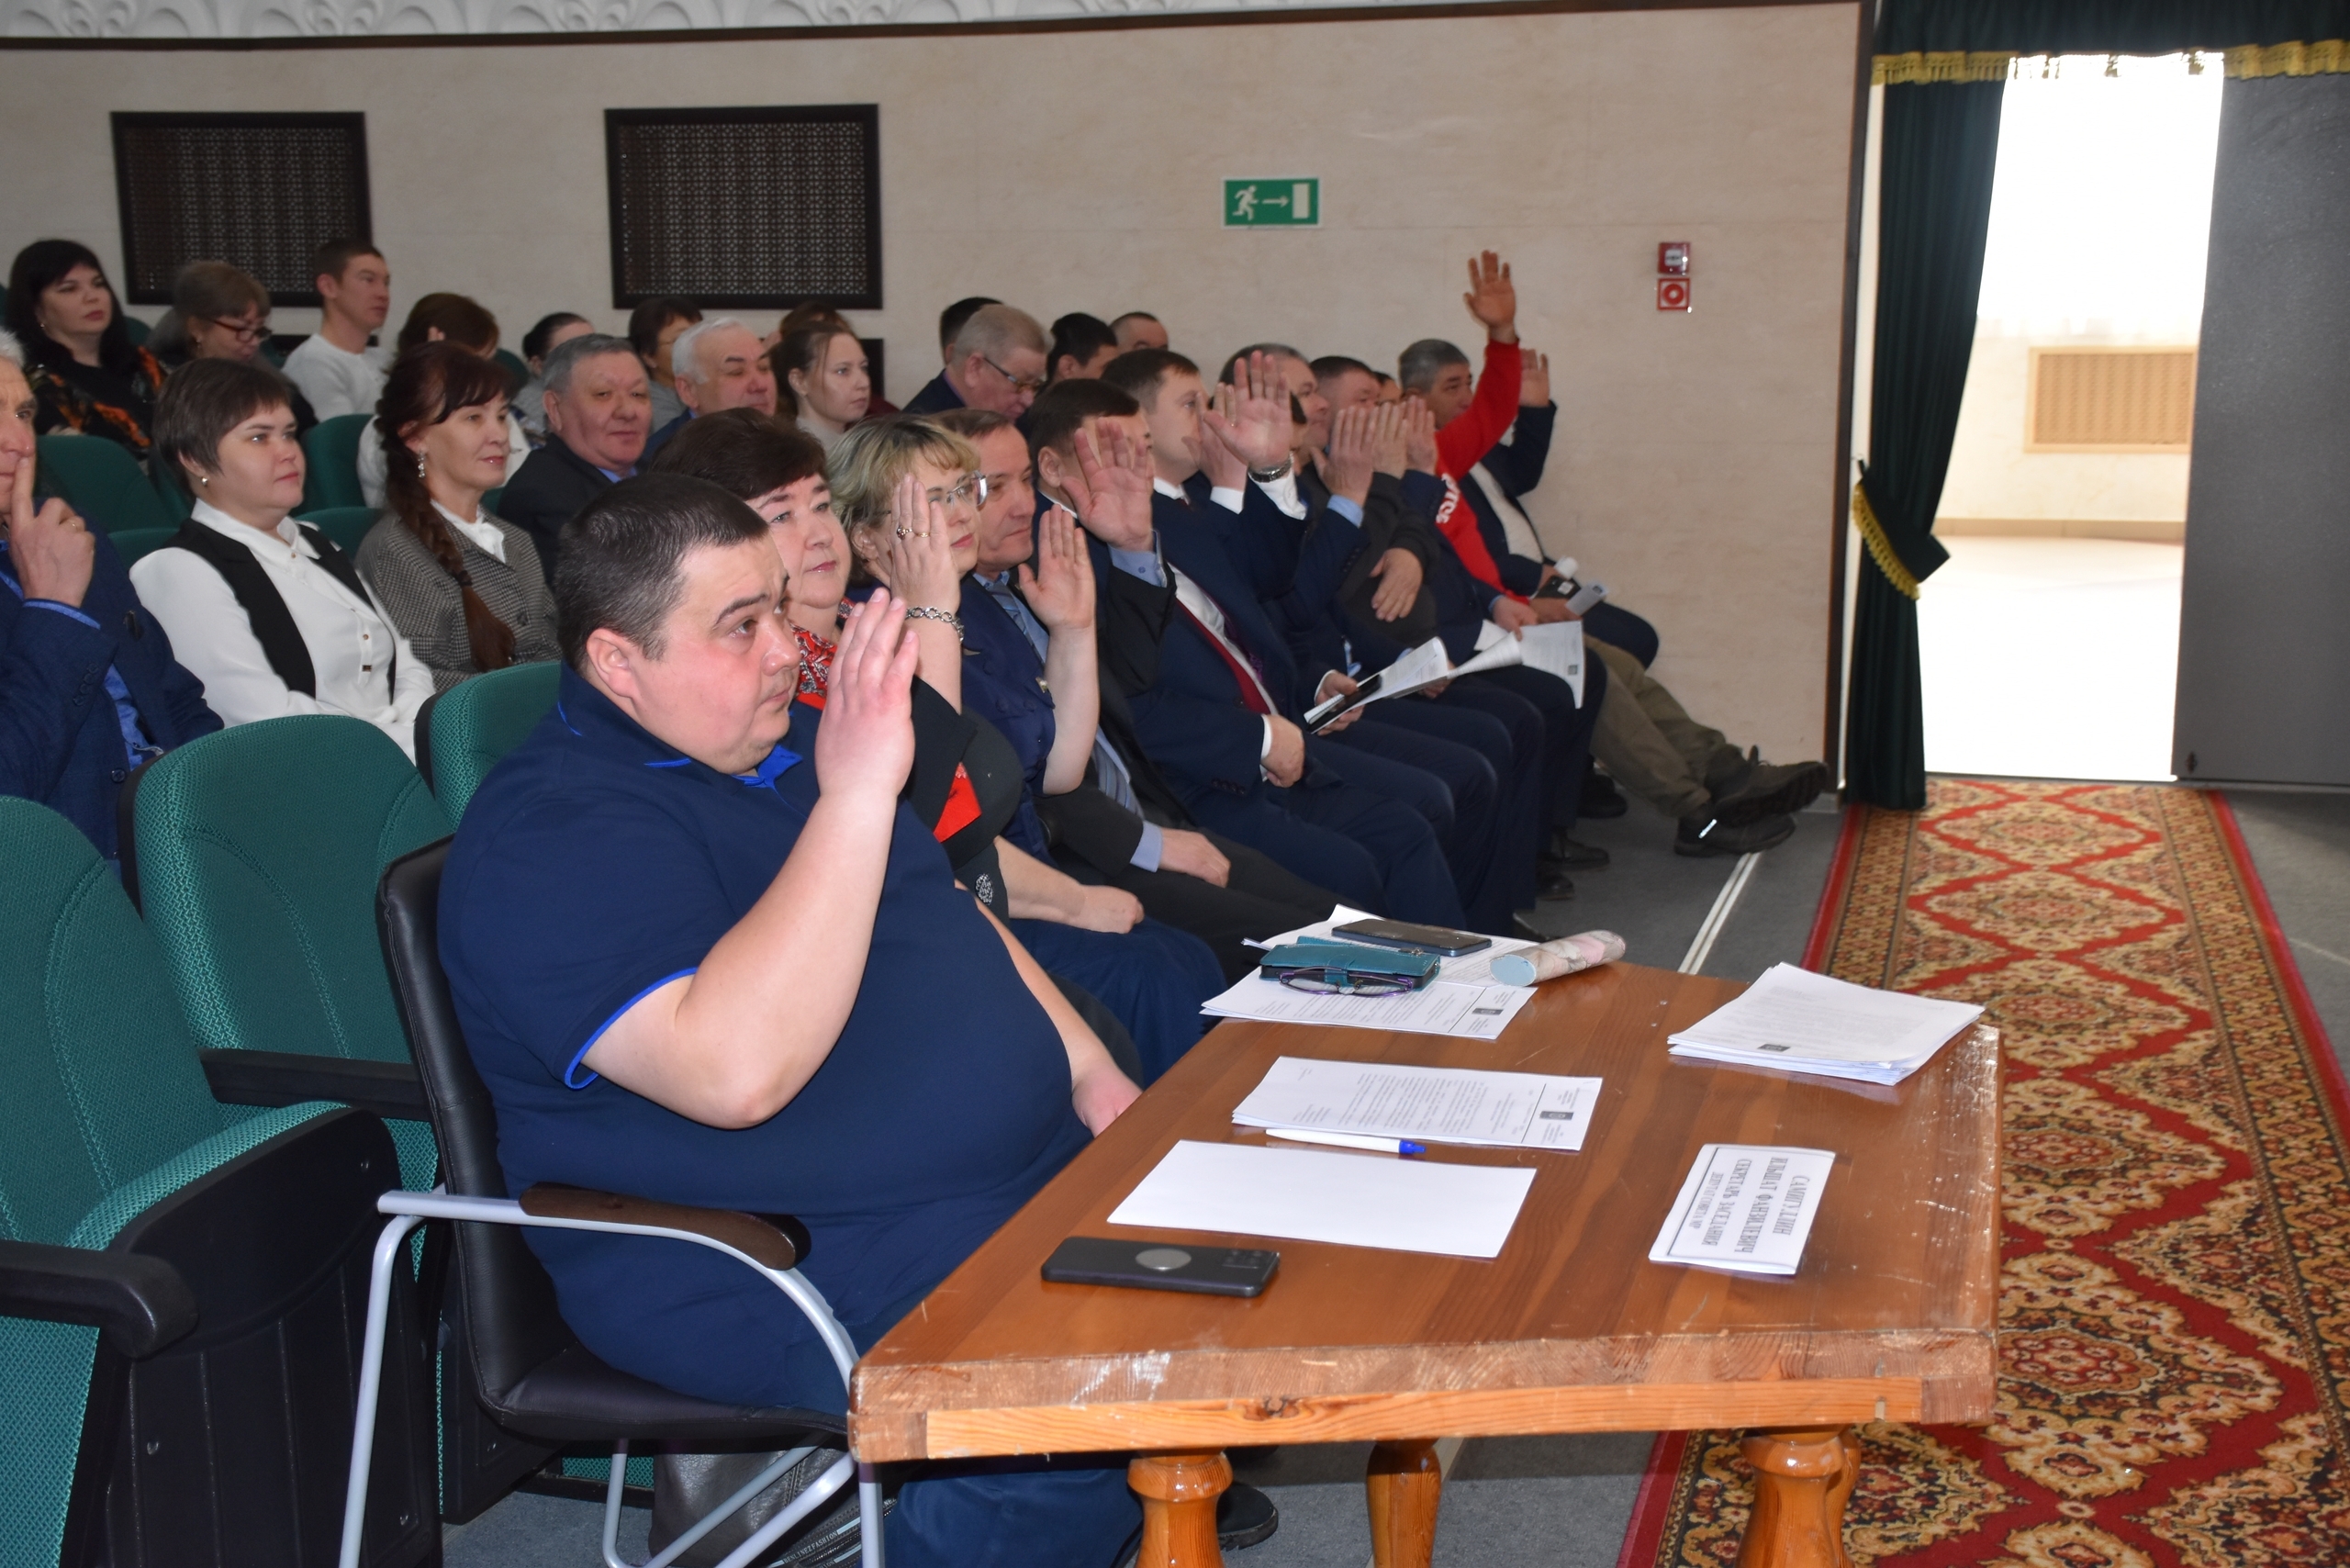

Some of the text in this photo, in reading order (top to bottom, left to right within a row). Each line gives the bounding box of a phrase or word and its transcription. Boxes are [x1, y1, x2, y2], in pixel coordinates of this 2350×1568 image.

[1701, 1159, 1752, 1246] СЕКРЕТАРЬ ЗАСЕДАНИЯ
[1734, 1157, 1788, 1253] ИЛЬШАТ ФАНЗИЛЕВИЧ
[1772, 1175, 1811, 1235] САМИГУЛЛИН
